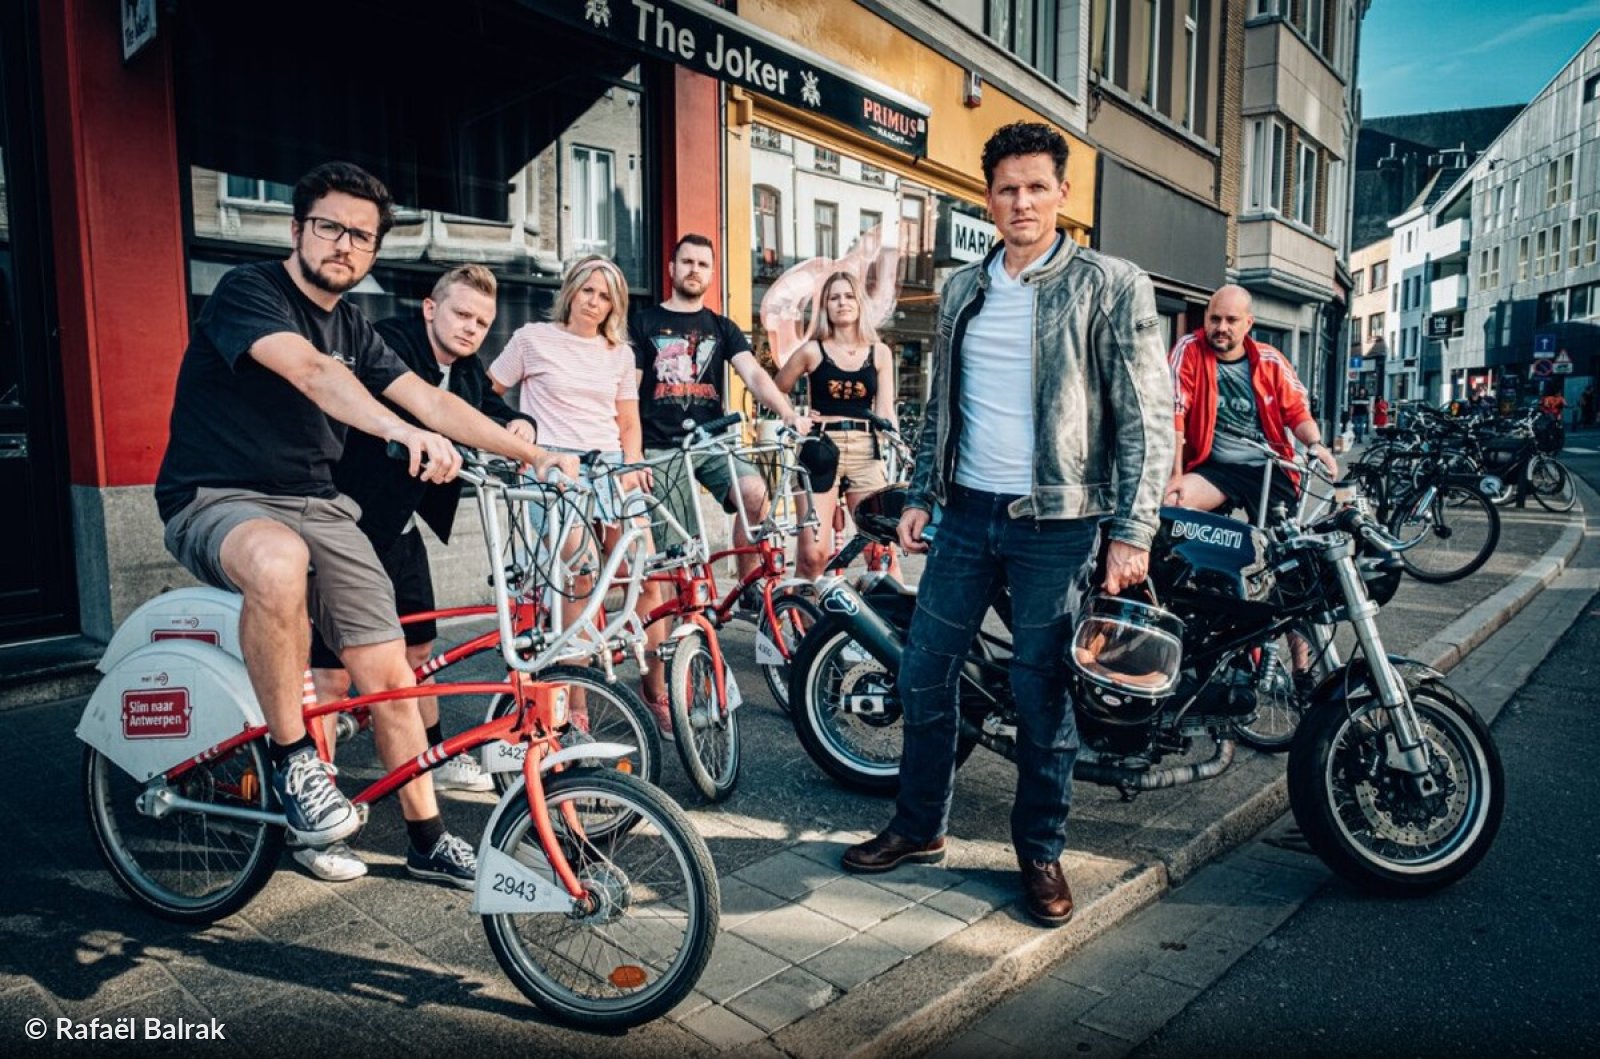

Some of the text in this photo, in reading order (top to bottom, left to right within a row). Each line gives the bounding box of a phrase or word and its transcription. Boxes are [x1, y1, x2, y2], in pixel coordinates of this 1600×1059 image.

[631, 0, 789, 95] The Joker
[863, 97, 917, 138] PRIMUS
[1171, 519, 1243, 549] DUCATI
[128, 701, 174, 713] Slim naar
[128, 714, 182, 728] Antwerpen
[492, 872, 537, 902] 2943
